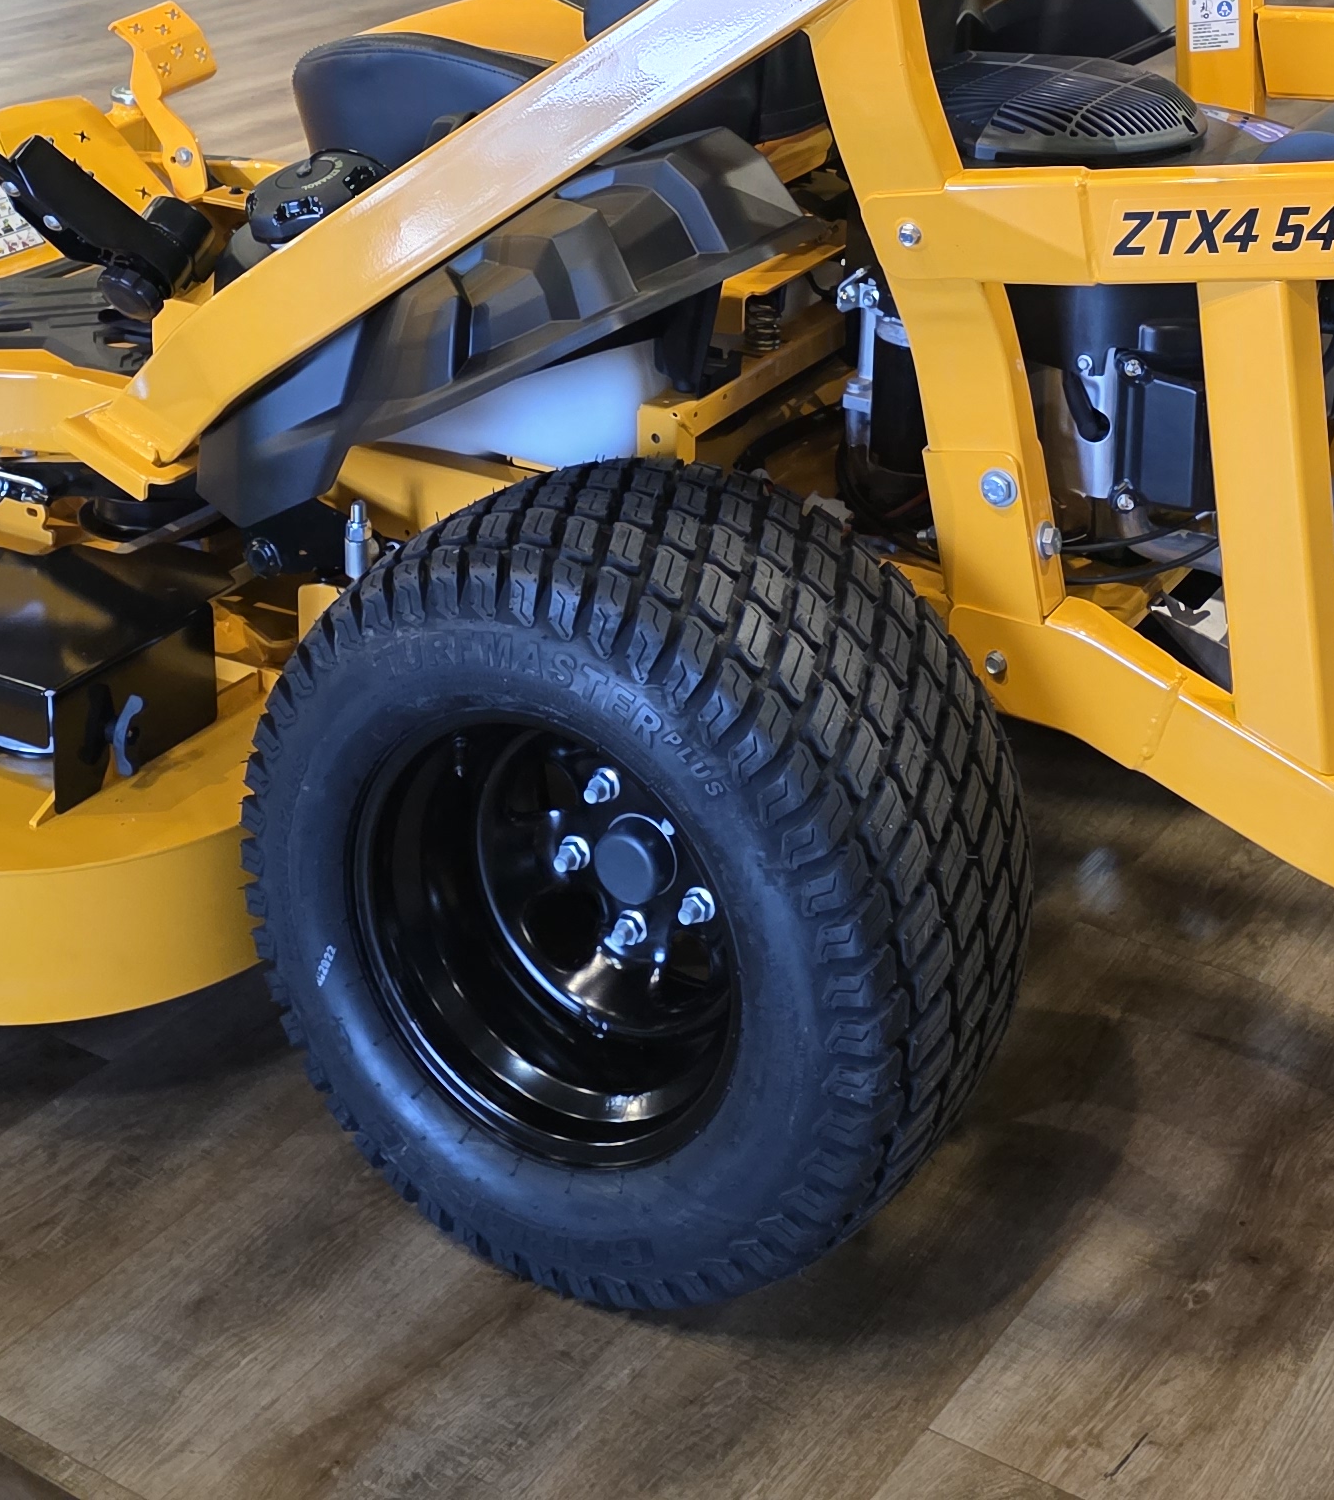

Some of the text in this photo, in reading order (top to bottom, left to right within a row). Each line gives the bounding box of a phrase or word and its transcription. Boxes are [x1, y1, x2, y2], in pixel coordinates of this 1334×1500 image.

[1112, 207, 1260, 256] ZTX4
[374, 630, 724, 797] TURFMASTER PLUS
